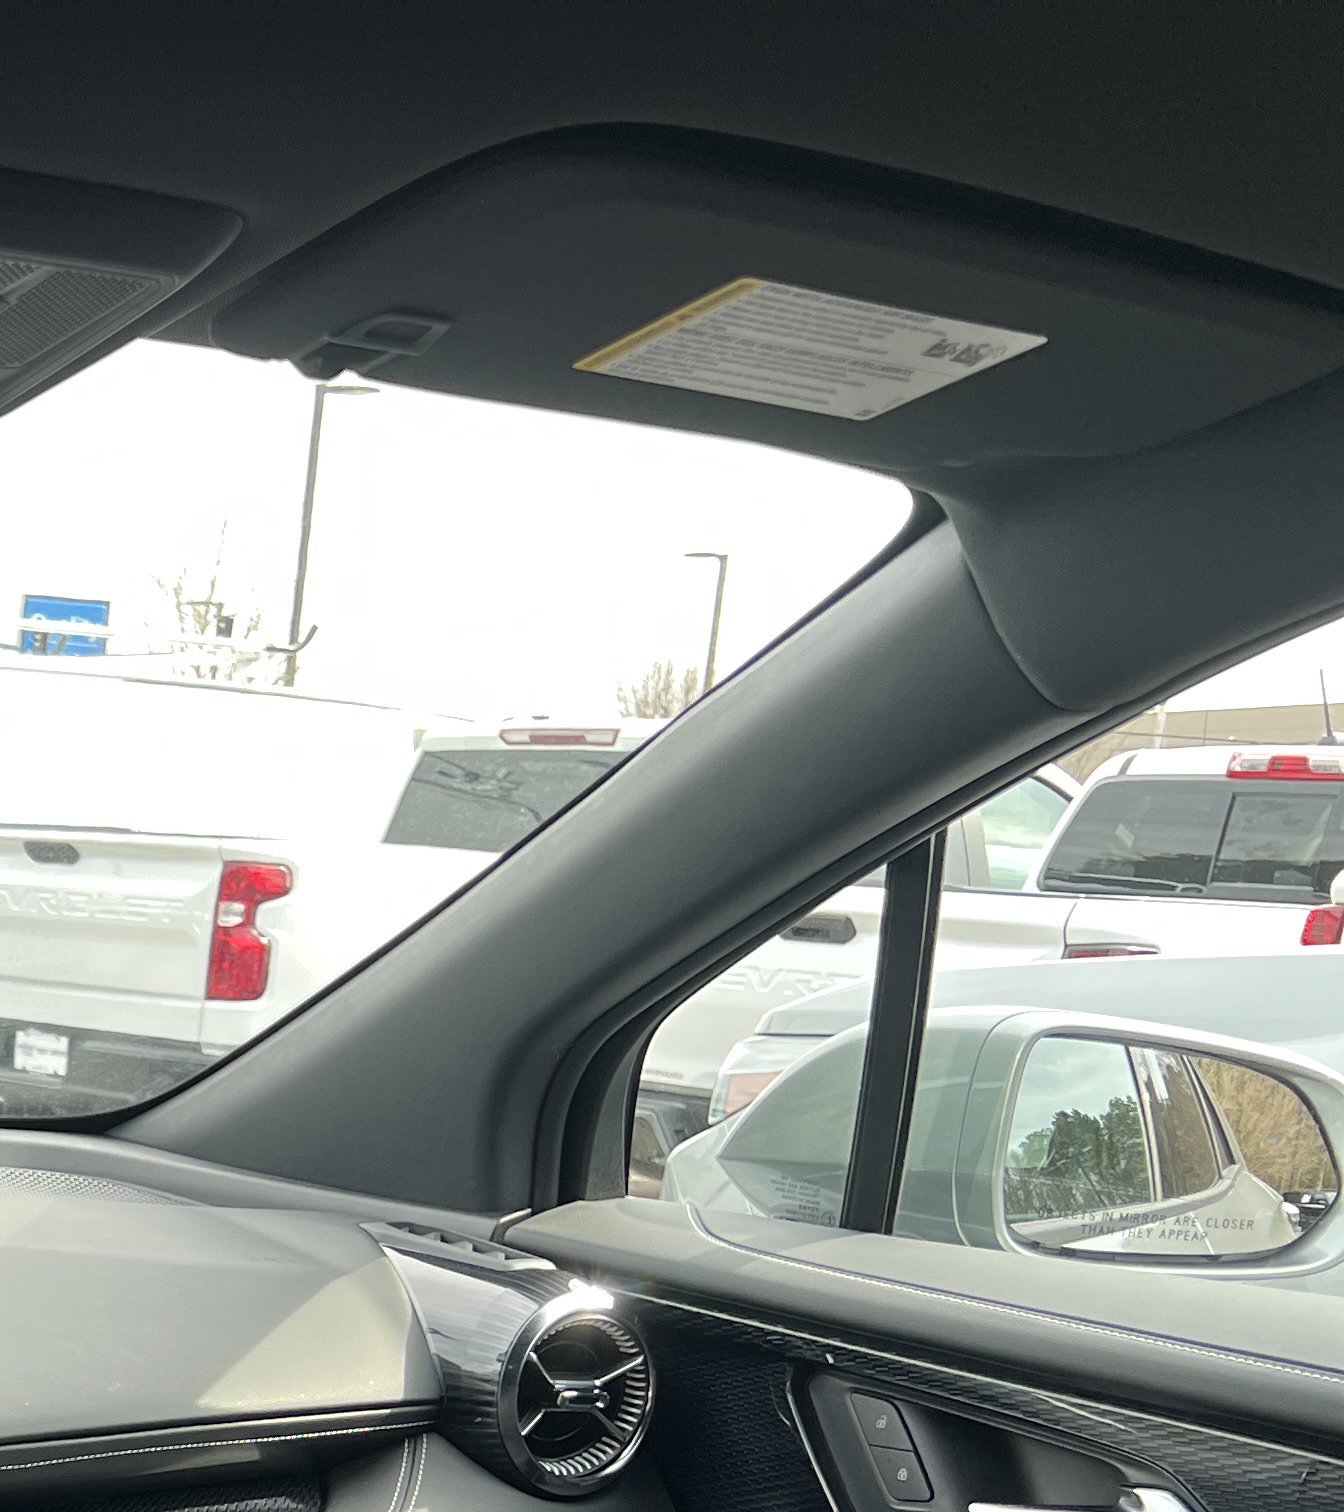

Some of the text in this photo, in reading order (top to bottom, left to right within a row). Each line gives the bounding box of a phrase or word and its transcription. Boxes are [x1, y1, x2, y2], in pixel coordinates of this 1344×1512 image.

[1101, 1211, 1113, 1222] IN
[1119, 1212, 1169, 1226] MIRROR
[1174, 1217, 1199, 1228] ARE
[1205, 1217, 1255, 1231] CLOSER
